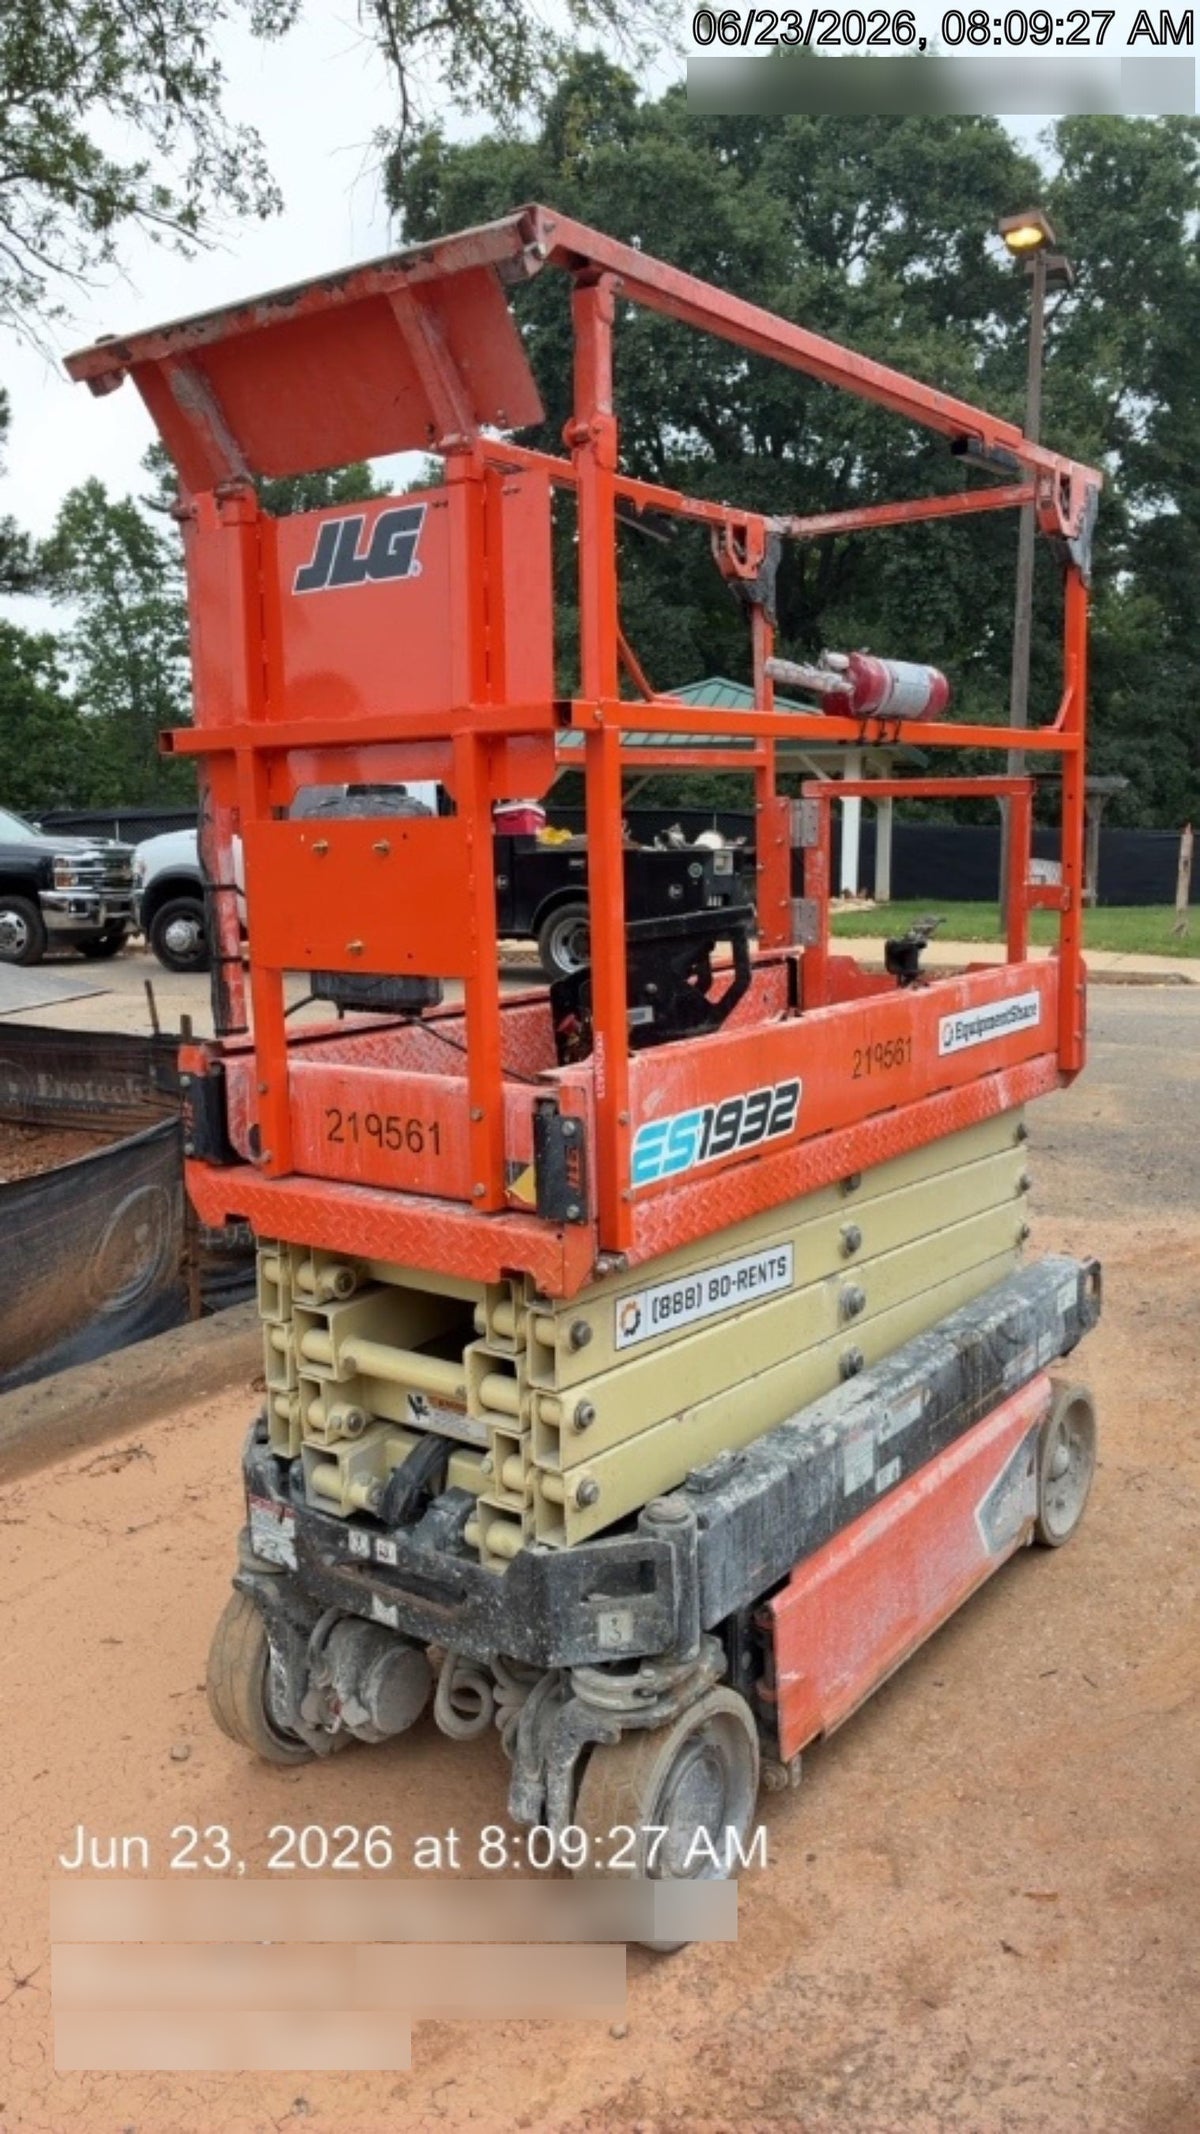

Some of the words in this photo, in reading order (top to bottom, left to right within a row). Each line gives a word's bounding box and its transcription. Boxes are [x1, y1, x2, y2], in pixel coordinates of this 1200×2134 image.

[292, 503, 427, 595] JLG
[955, 1003, 1037, 1042] EquipmentShare
[852, 1036, 912, 1080] 219561
[325, 1108, 440, 1156] 219561
[631, 1077, 801, 1188] ES1932
[651, 1282, 703, 1324] (888)
[708, 1256, 787, 1303] 80-RENTS
